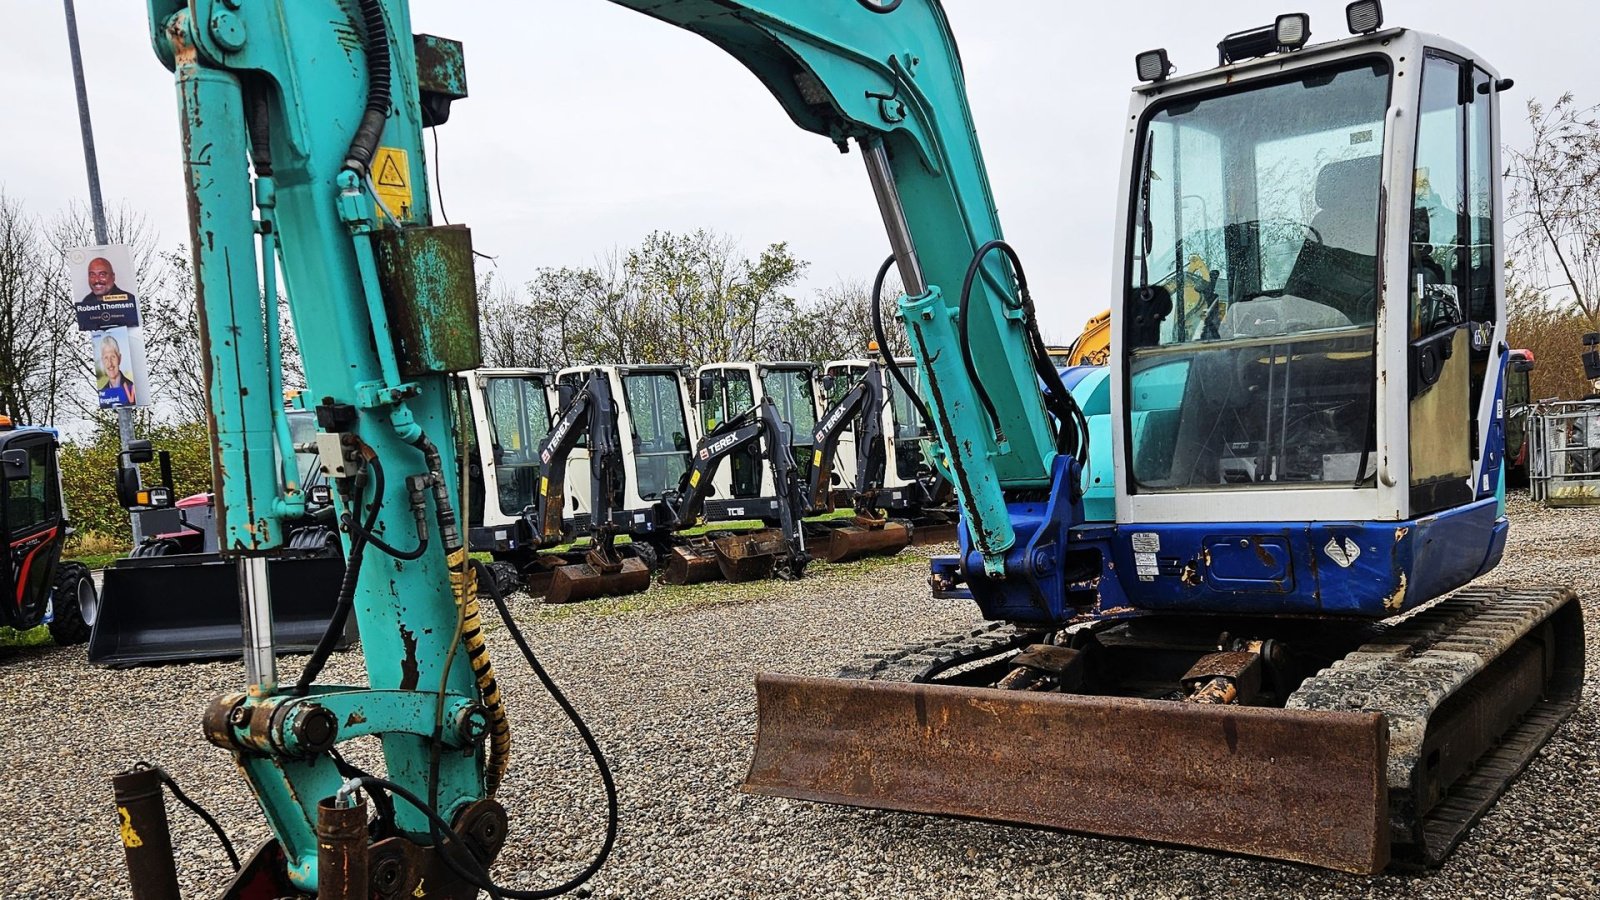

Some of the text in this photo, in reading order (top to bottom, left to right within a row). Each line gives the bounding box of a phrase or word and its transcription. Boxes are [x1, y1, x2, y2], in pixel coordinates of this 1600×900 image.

[77, 302, 135, 312] Robert Thomsen
[822, 402, 847, 433] TEREX
[547, 417, 571, 452] TEREX
[708, 431, 739, 454] TEREX
